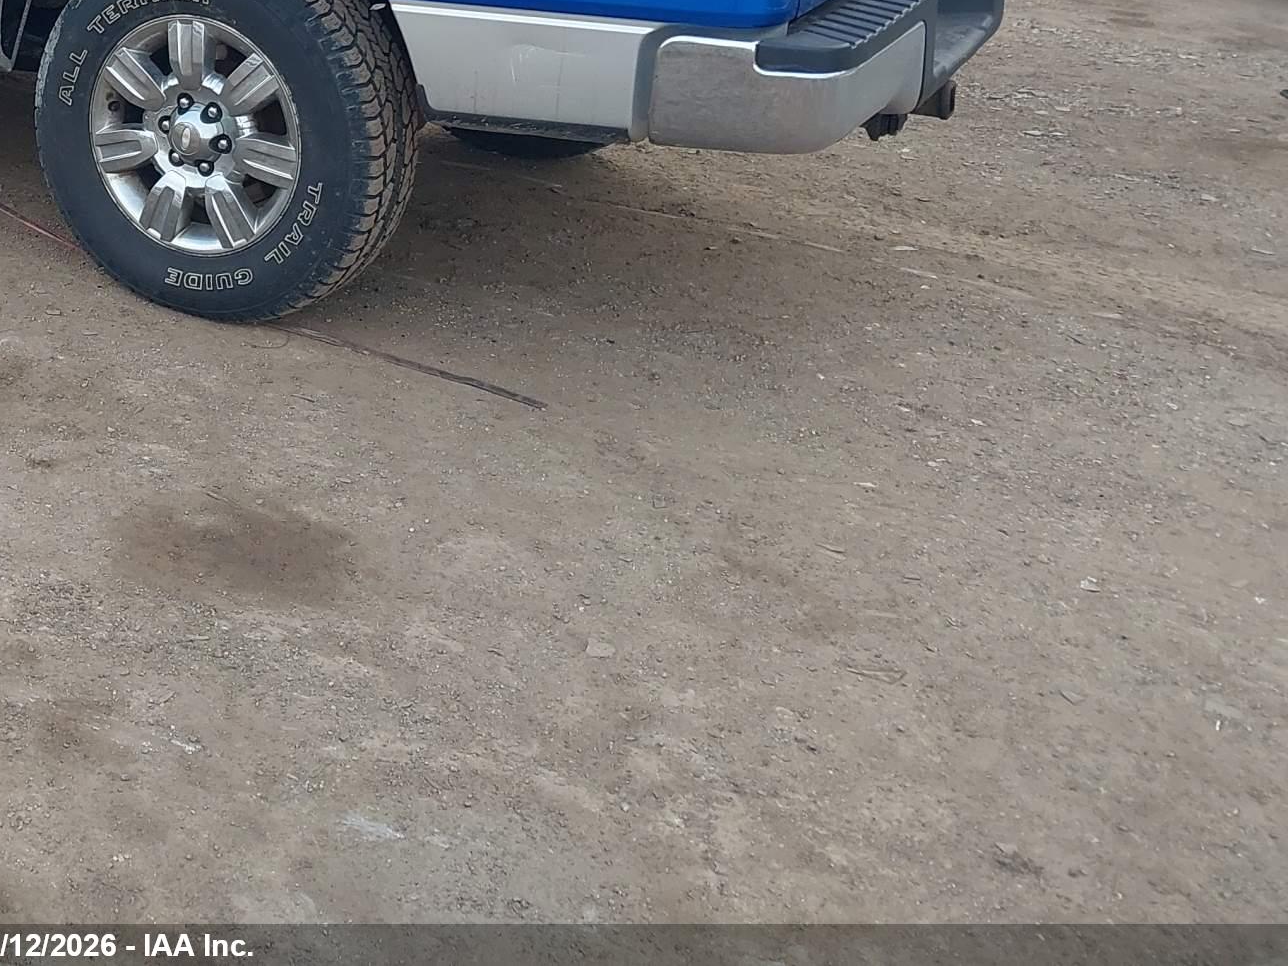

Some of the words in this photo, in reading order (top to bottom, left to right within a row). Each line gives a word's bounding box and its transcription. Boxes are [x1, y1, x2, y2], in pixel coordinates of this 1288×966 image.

[58, 49, 88, 106] ALL
[264, 182, 323, 264] TRAIL
[164, 266, 253, 291] GUIDE
